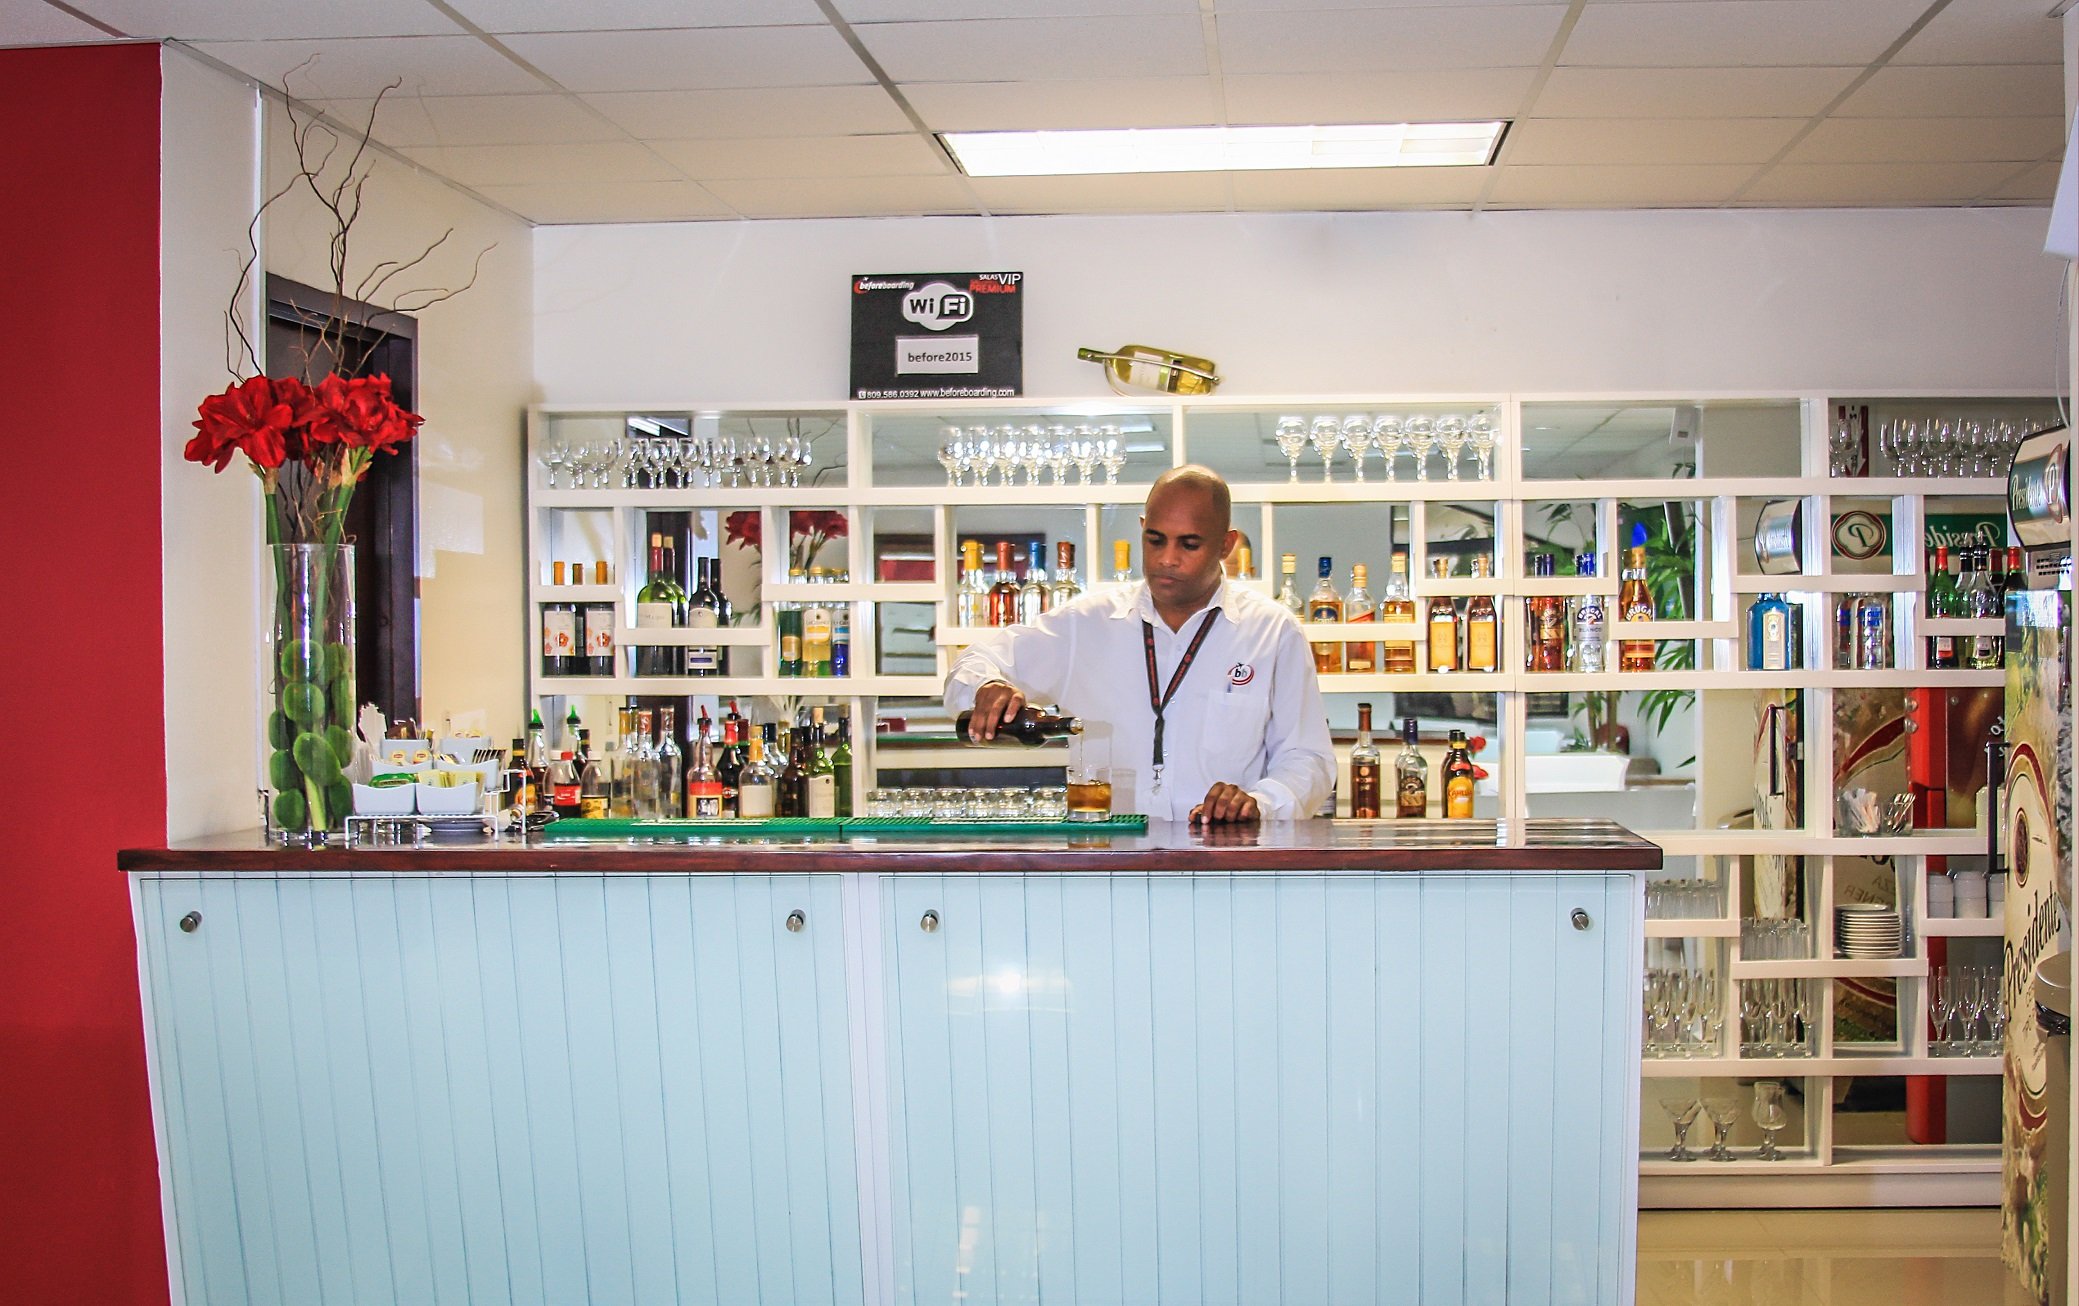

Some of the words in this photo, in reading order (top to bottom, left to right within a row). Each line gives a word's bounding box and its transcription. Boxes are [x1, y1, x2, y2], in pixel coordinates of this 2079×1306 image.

[859, 281, 915, 291] beforeboarding
[998, 274, 1021, 285] VIP
[969, 281, 1017, 294] PREMIUM
[909, 298, 935, 314] Wi
[943, 298, 966, 315] Fi
[907, 351, 973, 363] before2015
[920, 387, 1015, 398] www.beforeboarding.com
[1578, 606, 1603, 620] BRUGAL
[1625, 605, 1654, 621] BRUGAL
[2003, 880, 2061, 1023] Presidente
